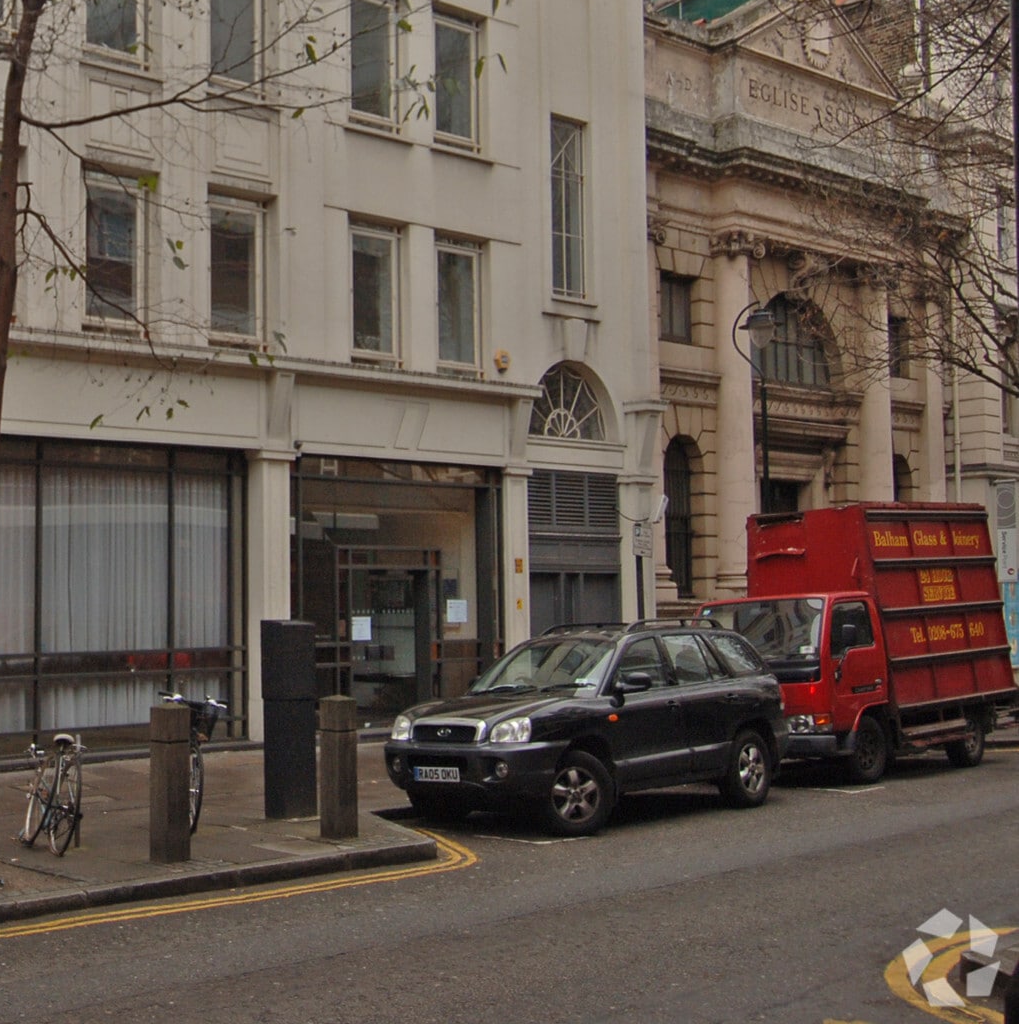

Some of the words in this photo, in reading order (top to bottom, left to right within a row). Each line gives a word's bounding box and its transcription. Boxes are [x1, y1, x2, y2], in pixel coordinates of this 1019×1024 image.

[748, 78, 809, 115] EGLISE
[873, 531, 909, 547] Balham
[913, 530, 938, 546] Glass
[940, 530, 947, 545] &
